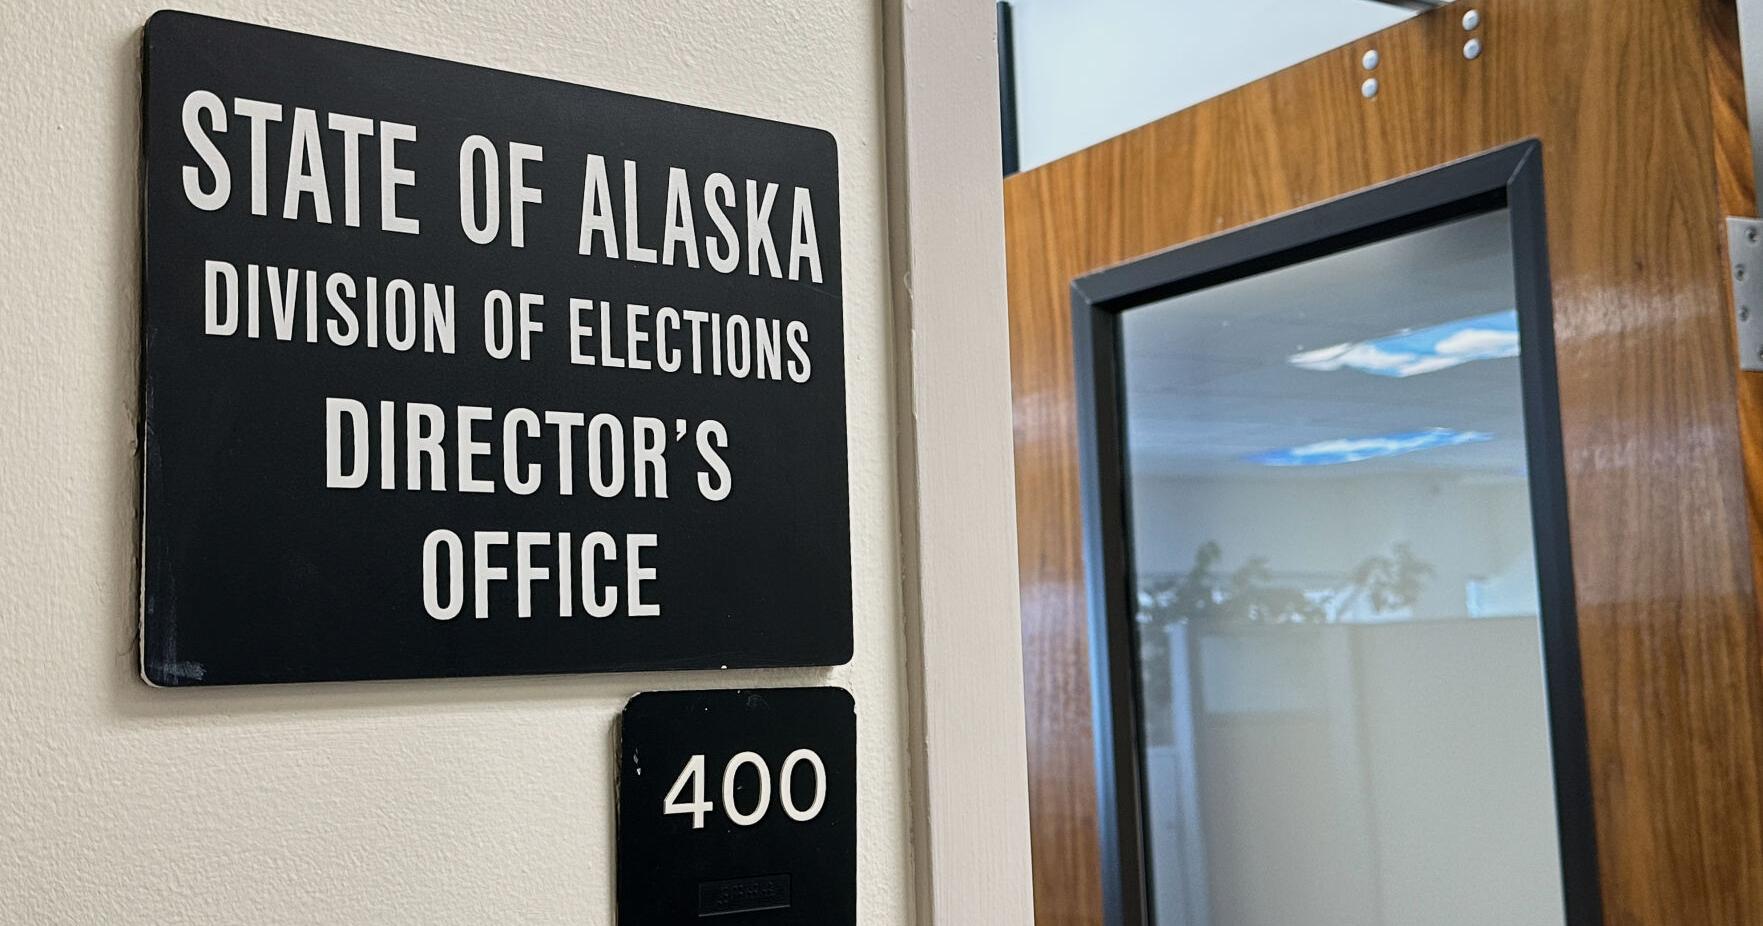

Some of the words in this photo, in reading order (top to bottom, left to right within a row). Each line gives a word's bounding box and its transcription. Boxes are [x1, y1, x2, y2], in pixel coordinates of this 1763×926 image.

[181, 89, 420, 235] STATE
[459, 134, 544, 248] OF
[578, 153, 823, 284] ALASKA
[204, 259, 456, 355] DIVISION
[484, 289, 545, 360] OF
[569, 297, 811, 383] ELECTIONS
[325, 397, 732, 502] DIRECTOR'S
[422, 528, 661, 621] OFFICE
[663, 748, 827, 829] 400
